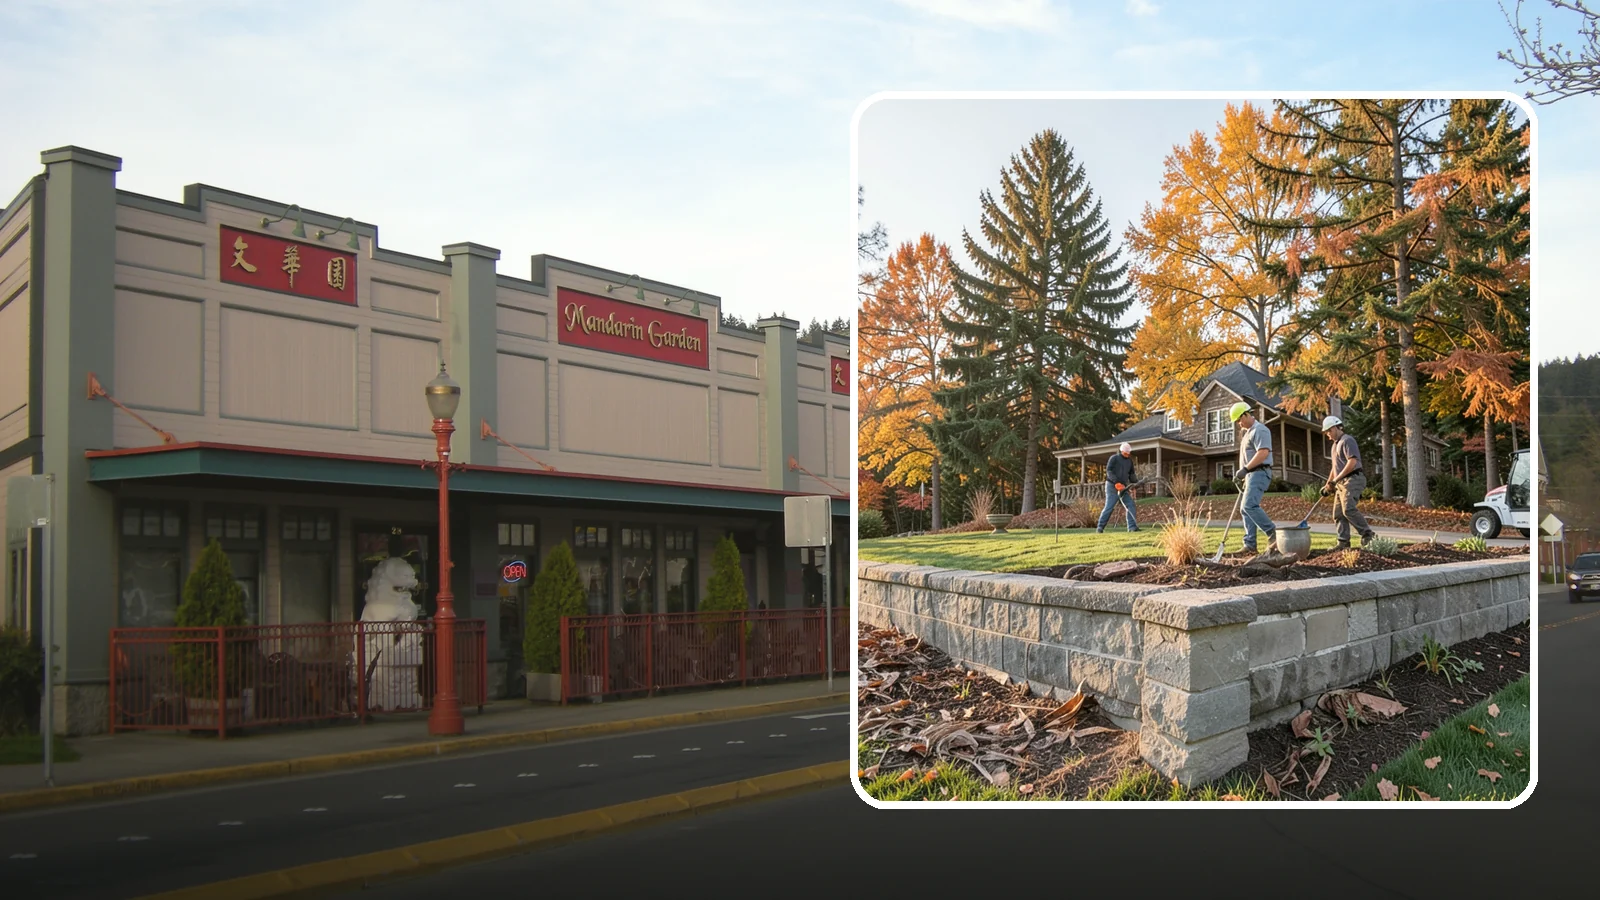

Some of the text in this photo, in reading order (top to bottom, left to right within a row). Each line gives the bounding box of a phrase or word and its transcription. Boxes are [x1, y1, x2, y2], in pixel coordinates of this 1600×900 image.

[230, 235, 346, 291] 文華園
[564, 302, 701, 352] Mandarin Garden
[503, 565, 527, 578] OPEN
